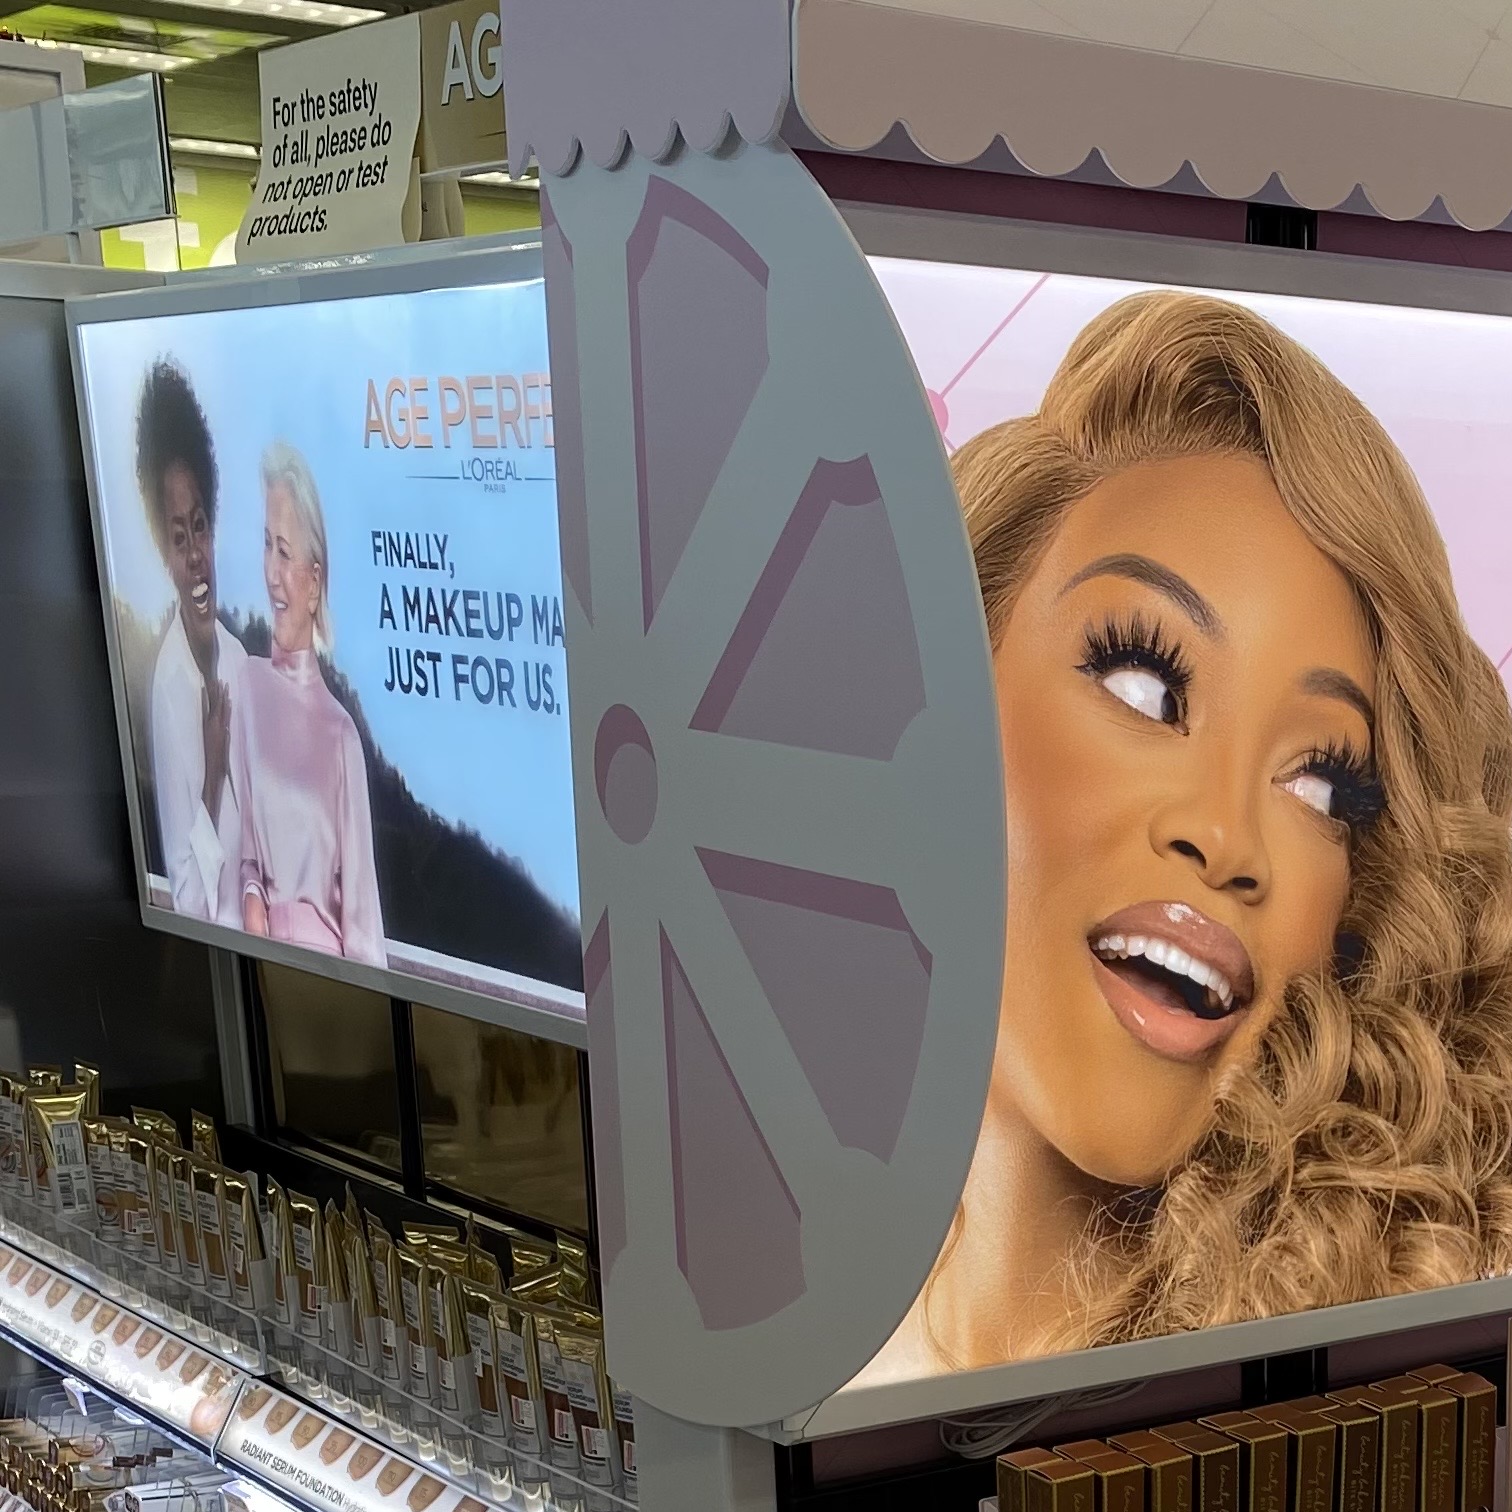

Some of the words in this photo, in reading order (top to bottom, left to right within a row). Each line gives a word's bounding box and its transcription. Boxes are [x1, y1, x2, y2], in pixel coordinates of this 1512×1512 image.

[273, 96, 297, 130] For
[301, 88, 325, 122] the
[329, 78, 378, 117] safety
[273, 133, 288, 168] of
[290, 129, 312, 167] all,
[315, 124, 366, 168] please
[371, 113, 392, 148] do
[262, 173, 293, 204] not
[292, 169, 333, 206] open
[336, 165, 354, 194] or
[355, 155, 389, 189] test
[247, 205, 328, 245] products.
[364, 377, 433, 449] AGE
[484, 483, 506, 494] PARIS
[371, 531, 455, 578] FINALLY,
[379, 583, 397, 630] A
[401, 585, 523, 642] MAKEUP
[385, 646, 442, 698] JUST
[451, 653, 516, 708] FOR
[524, 661, 561, 715] US.
[239, 1438, 272, 1469] RADIANT
[270, 1454, 296, 1482] SERUM
[294, 1468, 345, 1507] FOUNDATION
